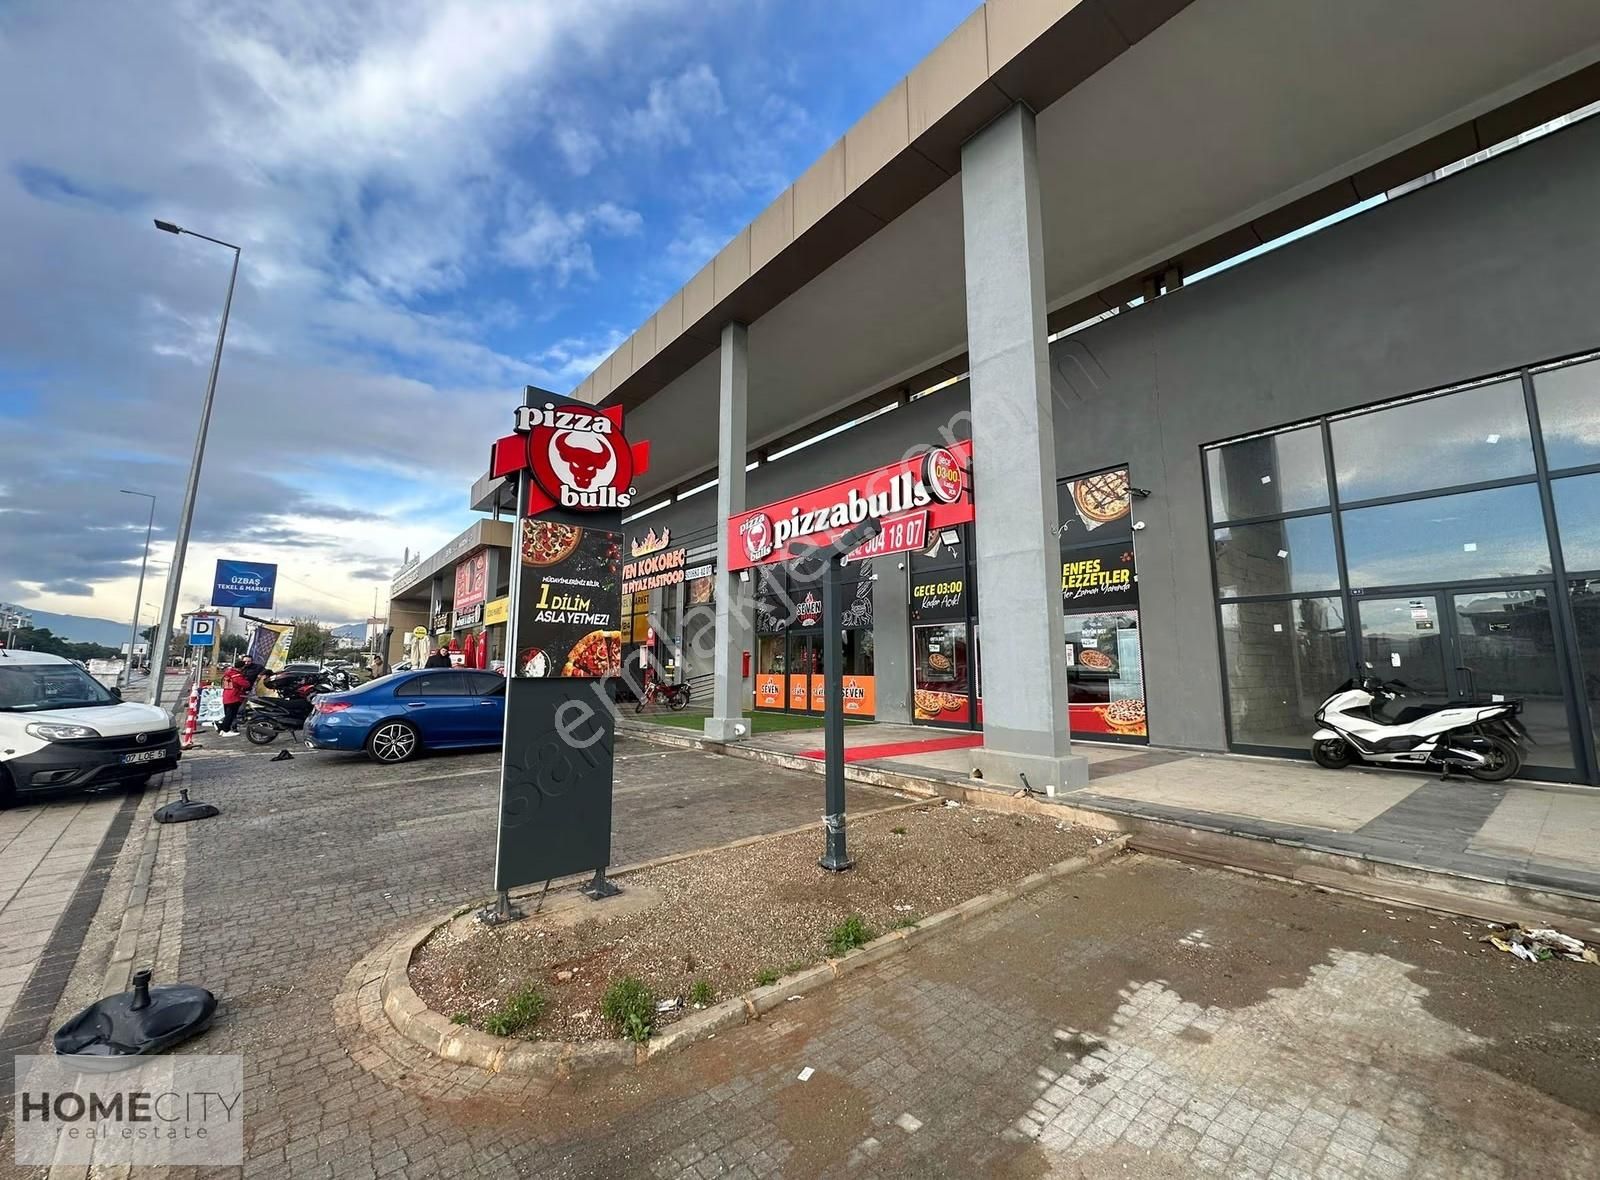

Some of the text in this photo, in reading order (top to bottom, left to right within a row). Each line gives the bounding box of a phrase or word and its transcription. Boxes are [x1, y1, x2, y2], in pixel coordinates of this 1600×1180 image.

[517, 403, 612, 434] pizza
[773, 471, 931, 549] pizzabulls
[739, 513, 765, 536] pizza
[888, 523, 903, 549] 18
[906, 518, 923, 546] 07
[638, 548, 686, 577] KOKOREÇ
[1062, 559, 1101, 577] ENFES
[217, 583, 239, 591] TEKEL
[245, 585, 272, 593] MARKET
[231, 575, 261, 587] ÜZBAŞ
[648, 569, 685, 590] FASTFOOD
[1062, 568, 1131, 590] LEZZETLER
[535, 583, 591, 612] 1 DİLİM
[914, 581, 963, 598] GECE 03:00
[534, 610, 610, 626] ASLA YETMEZ!
[796, 600, 822, 618] SEVEN
[196, 621, 210, 634] D
[761, 684, 779, 695] SEVEN
